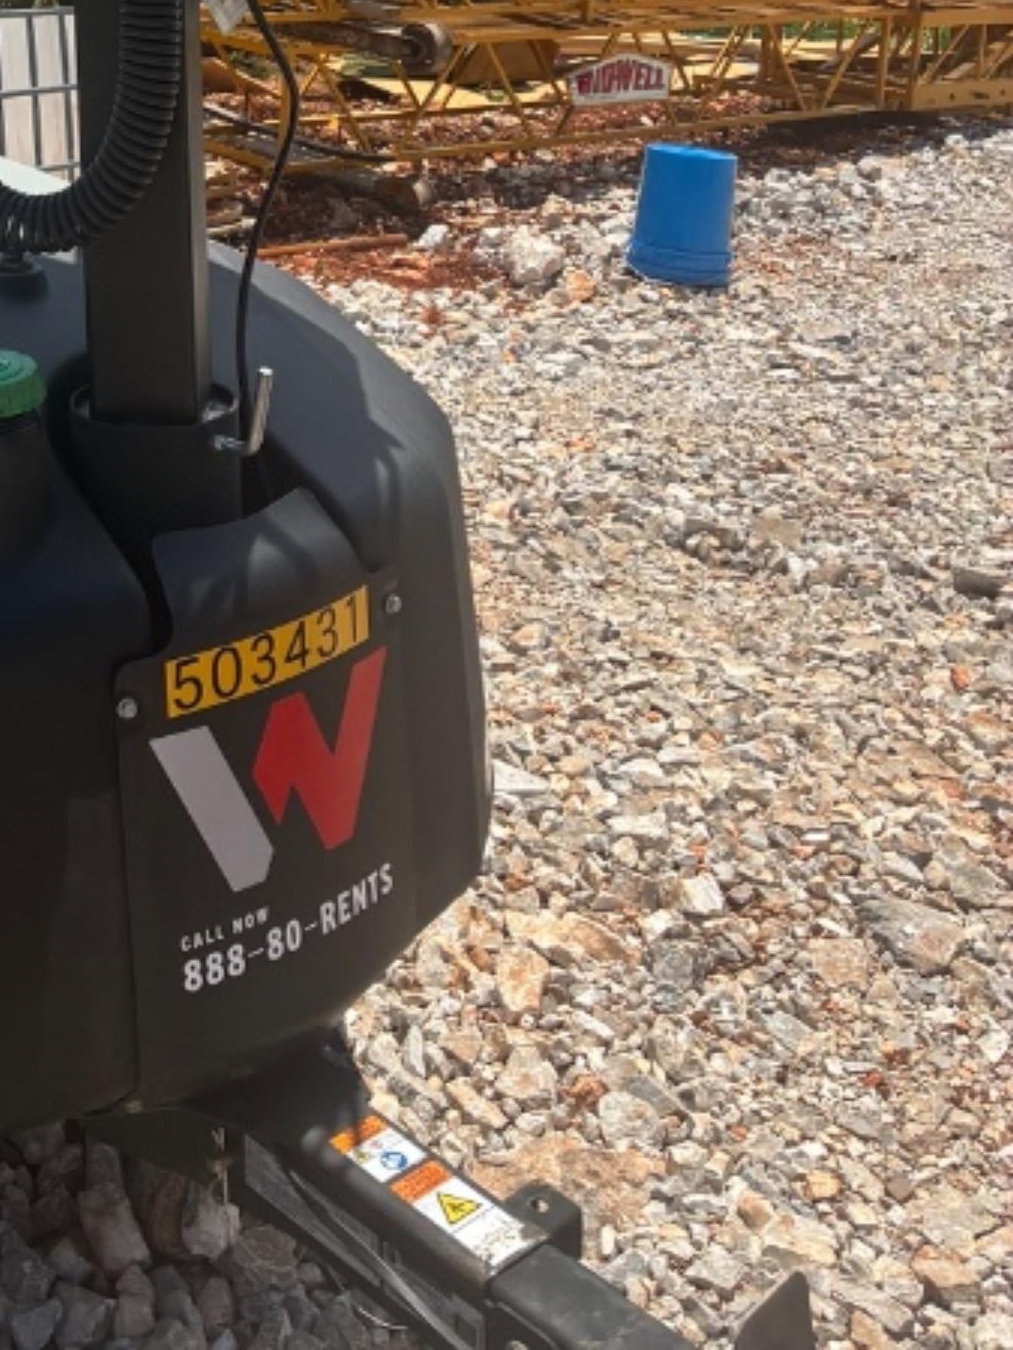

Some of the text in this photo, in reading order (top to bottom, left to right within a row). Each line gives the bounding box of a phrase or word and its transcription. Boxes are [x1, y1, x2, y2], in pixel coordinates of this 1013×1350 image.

[173, 595, 361, 711] 503431
[180, 904, 270, 952] CALL NOW
[183, 861, 394, 992] 888-80-RENTS
